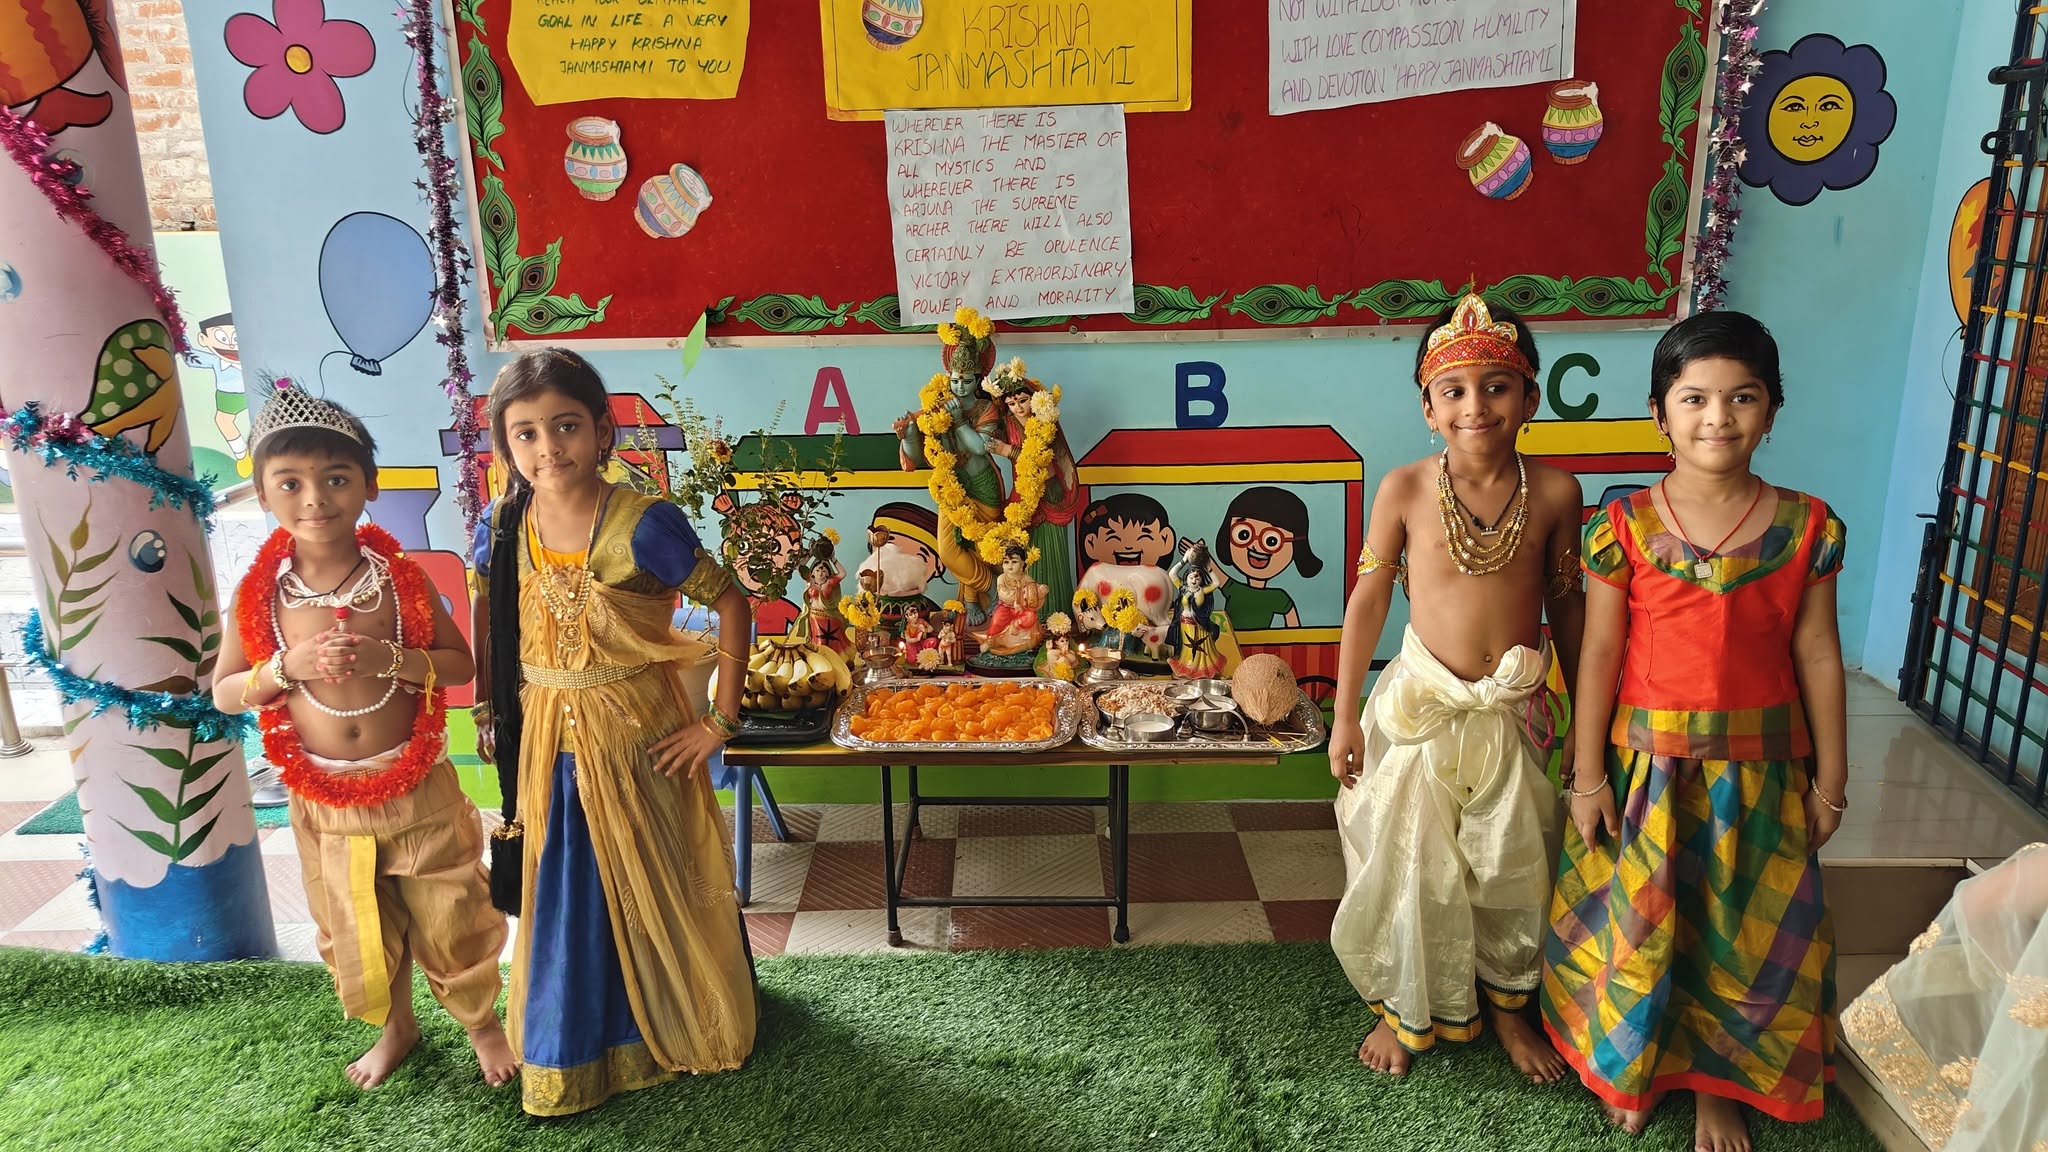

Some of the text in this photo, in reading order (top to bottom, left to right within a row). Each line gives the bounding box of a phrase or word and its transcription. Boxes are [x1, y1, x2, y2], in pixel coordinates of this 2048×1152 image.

[538, 12, 729, 28] GOAL IN LIFE A VERY
[962, 2, 1091, 49] KRISHNA
[571, 36, 702, 51] HAPPY KRISHNA
[1281, 7, 1550, 63] WITH LOVE COMPASSION HUMILITY
[666, 58, 687, 74] TO
[697, 58, 732, 75] YOU
[905, 45, 1136, 92] JANMASHTAMI
[1281, 78, 1312, 104] AND
[1317, 68, 1385, 100] DEVOTION
[1441, 43, 1557, 85] JANMASHTAMI
[892, 111, 1057, 134] WHEREVER THERE IS
[894, 130, 1122, 157] KRISHNA THE MASTER OF
[897, 156, 1047, 179] ALL MYSTICS AND
[902, 173, 1076, 199] WHEREVER THERE IS
[903, 195, 1079, 218] ARJUNA THE SUPREME
[905, 211, 1114, 238] ARCHER THERE WILL ALSO
[905, 235, 1122, 263] CERTAINLY BE OPULENCE
[910, 260, 1127, 291] VICTORY EXTRAORDINARY
[985, 294, 1020, 310] AND
[1038, 286, 1118, 308] MORALITY
[1174, 361, 1231, 430] B
[1546, 352, 1601, 421] C
[804, 366, 861, 436] A
